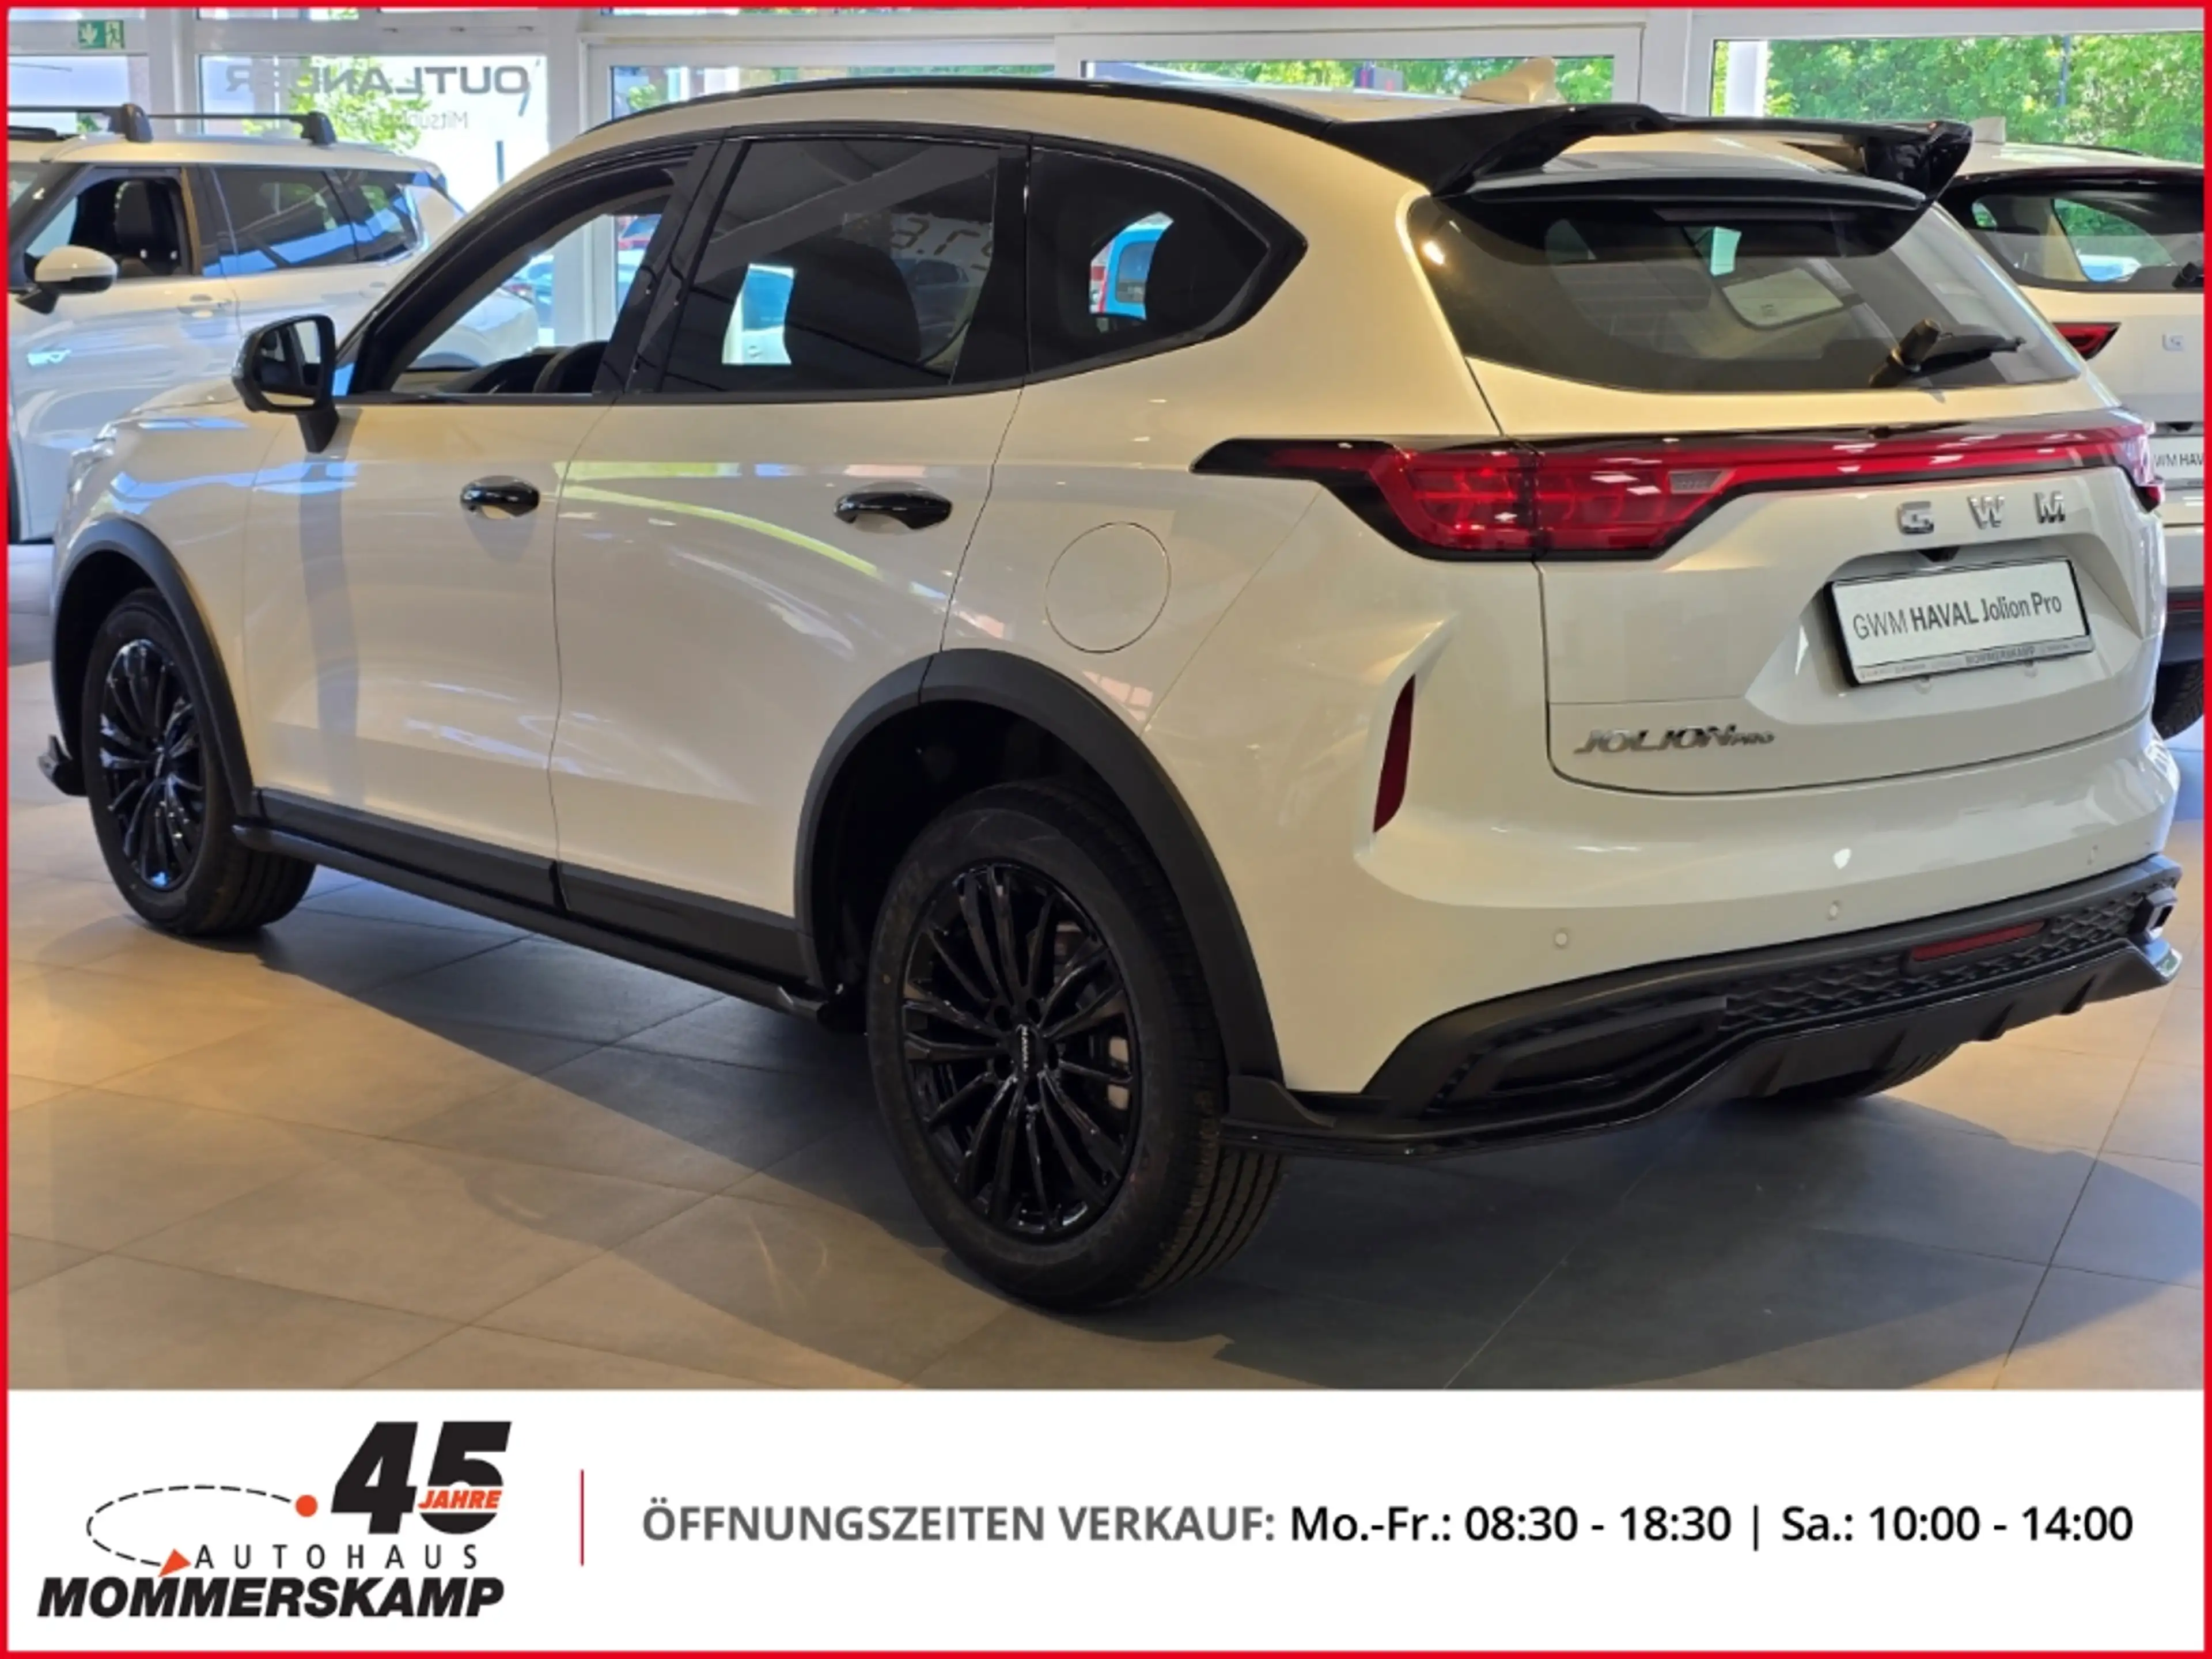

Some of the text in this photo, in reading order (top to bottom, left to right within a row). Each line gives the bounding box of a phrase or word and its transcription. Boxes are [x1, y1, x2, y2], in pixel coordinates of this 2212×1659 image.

[1853, 592, 2062, 640] GWM HAVAL Jolion Pro
[1573, 724, 1737, 754] JOLION
